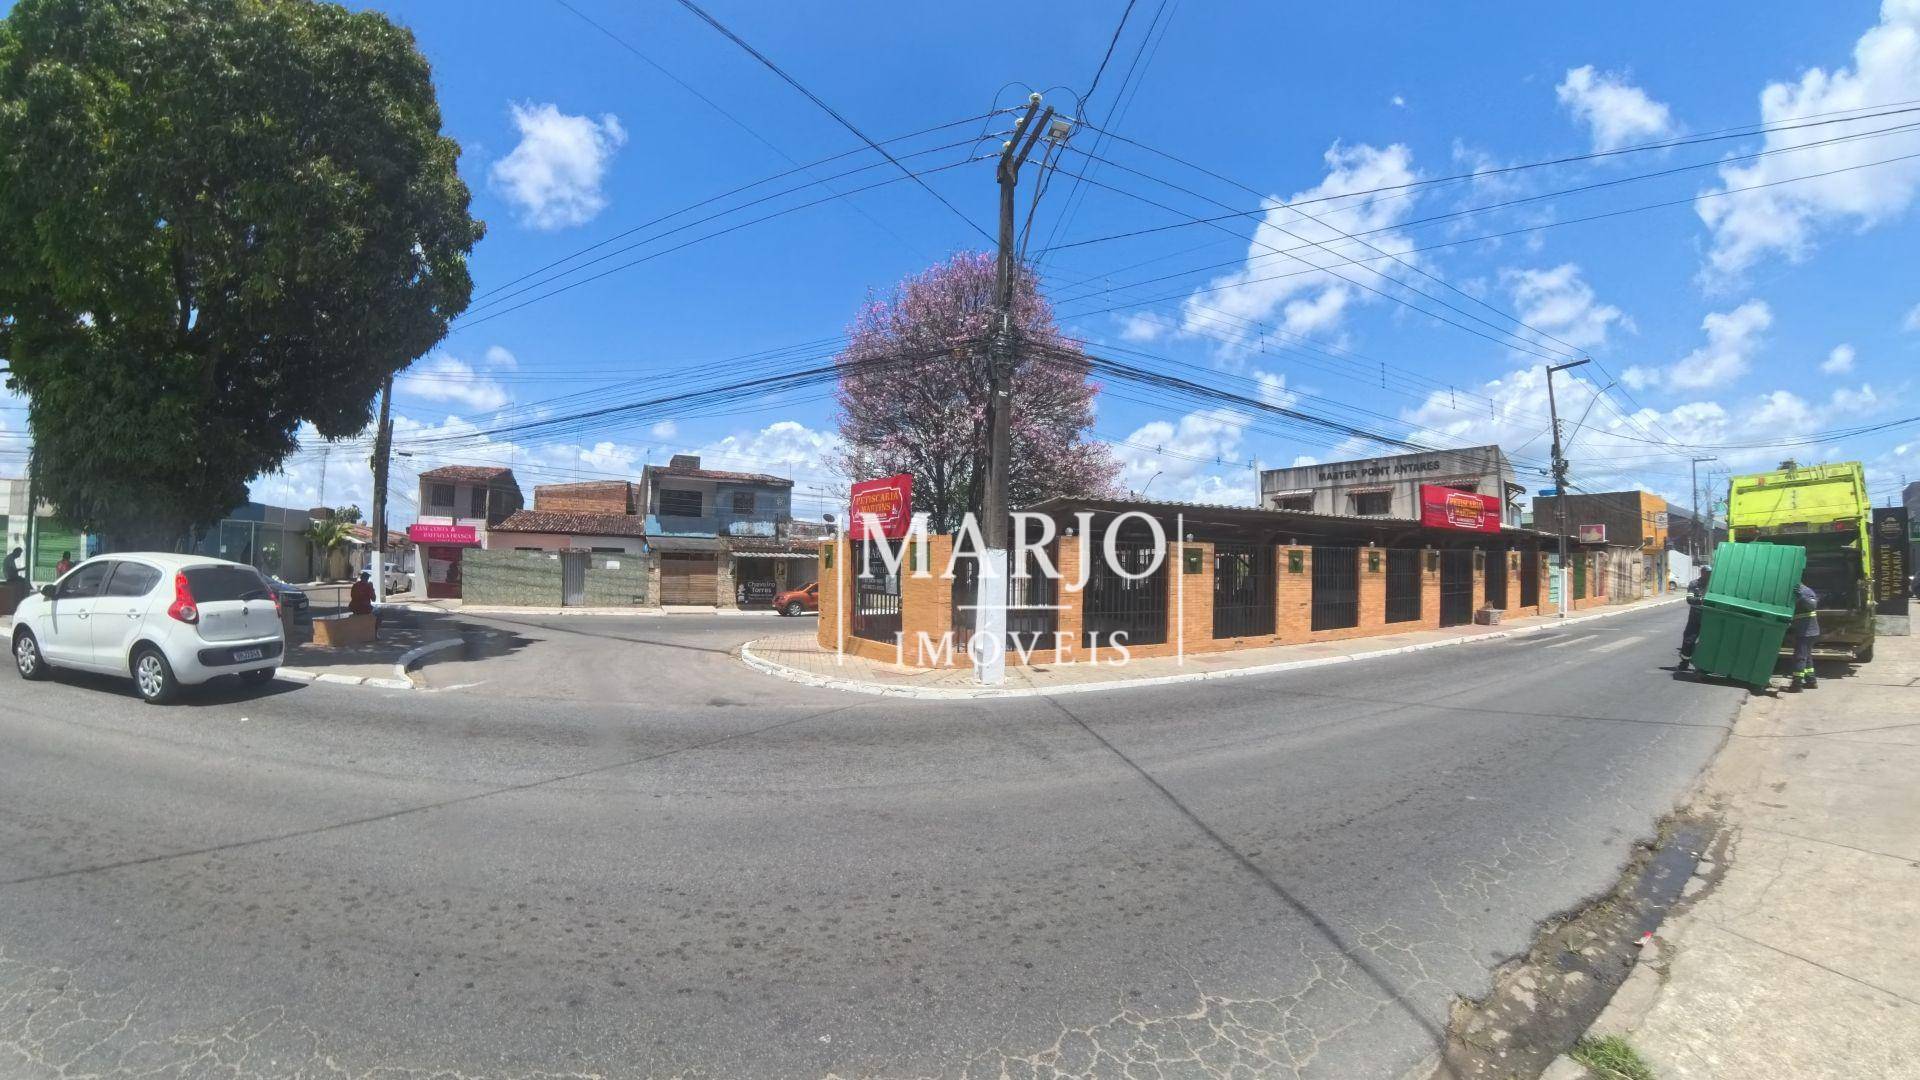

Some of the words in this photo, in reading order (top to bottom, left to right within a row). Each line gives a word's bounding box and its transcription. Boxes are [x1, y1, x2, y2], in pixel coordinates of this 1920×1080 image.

[1318, 471, 1357, 482] MASTER
[1361, 467, 1390, 477] POINT
[1393, 460, 1440, 474] ANTARES
[1880, 544, 1890, 600] RESTAURANTE
